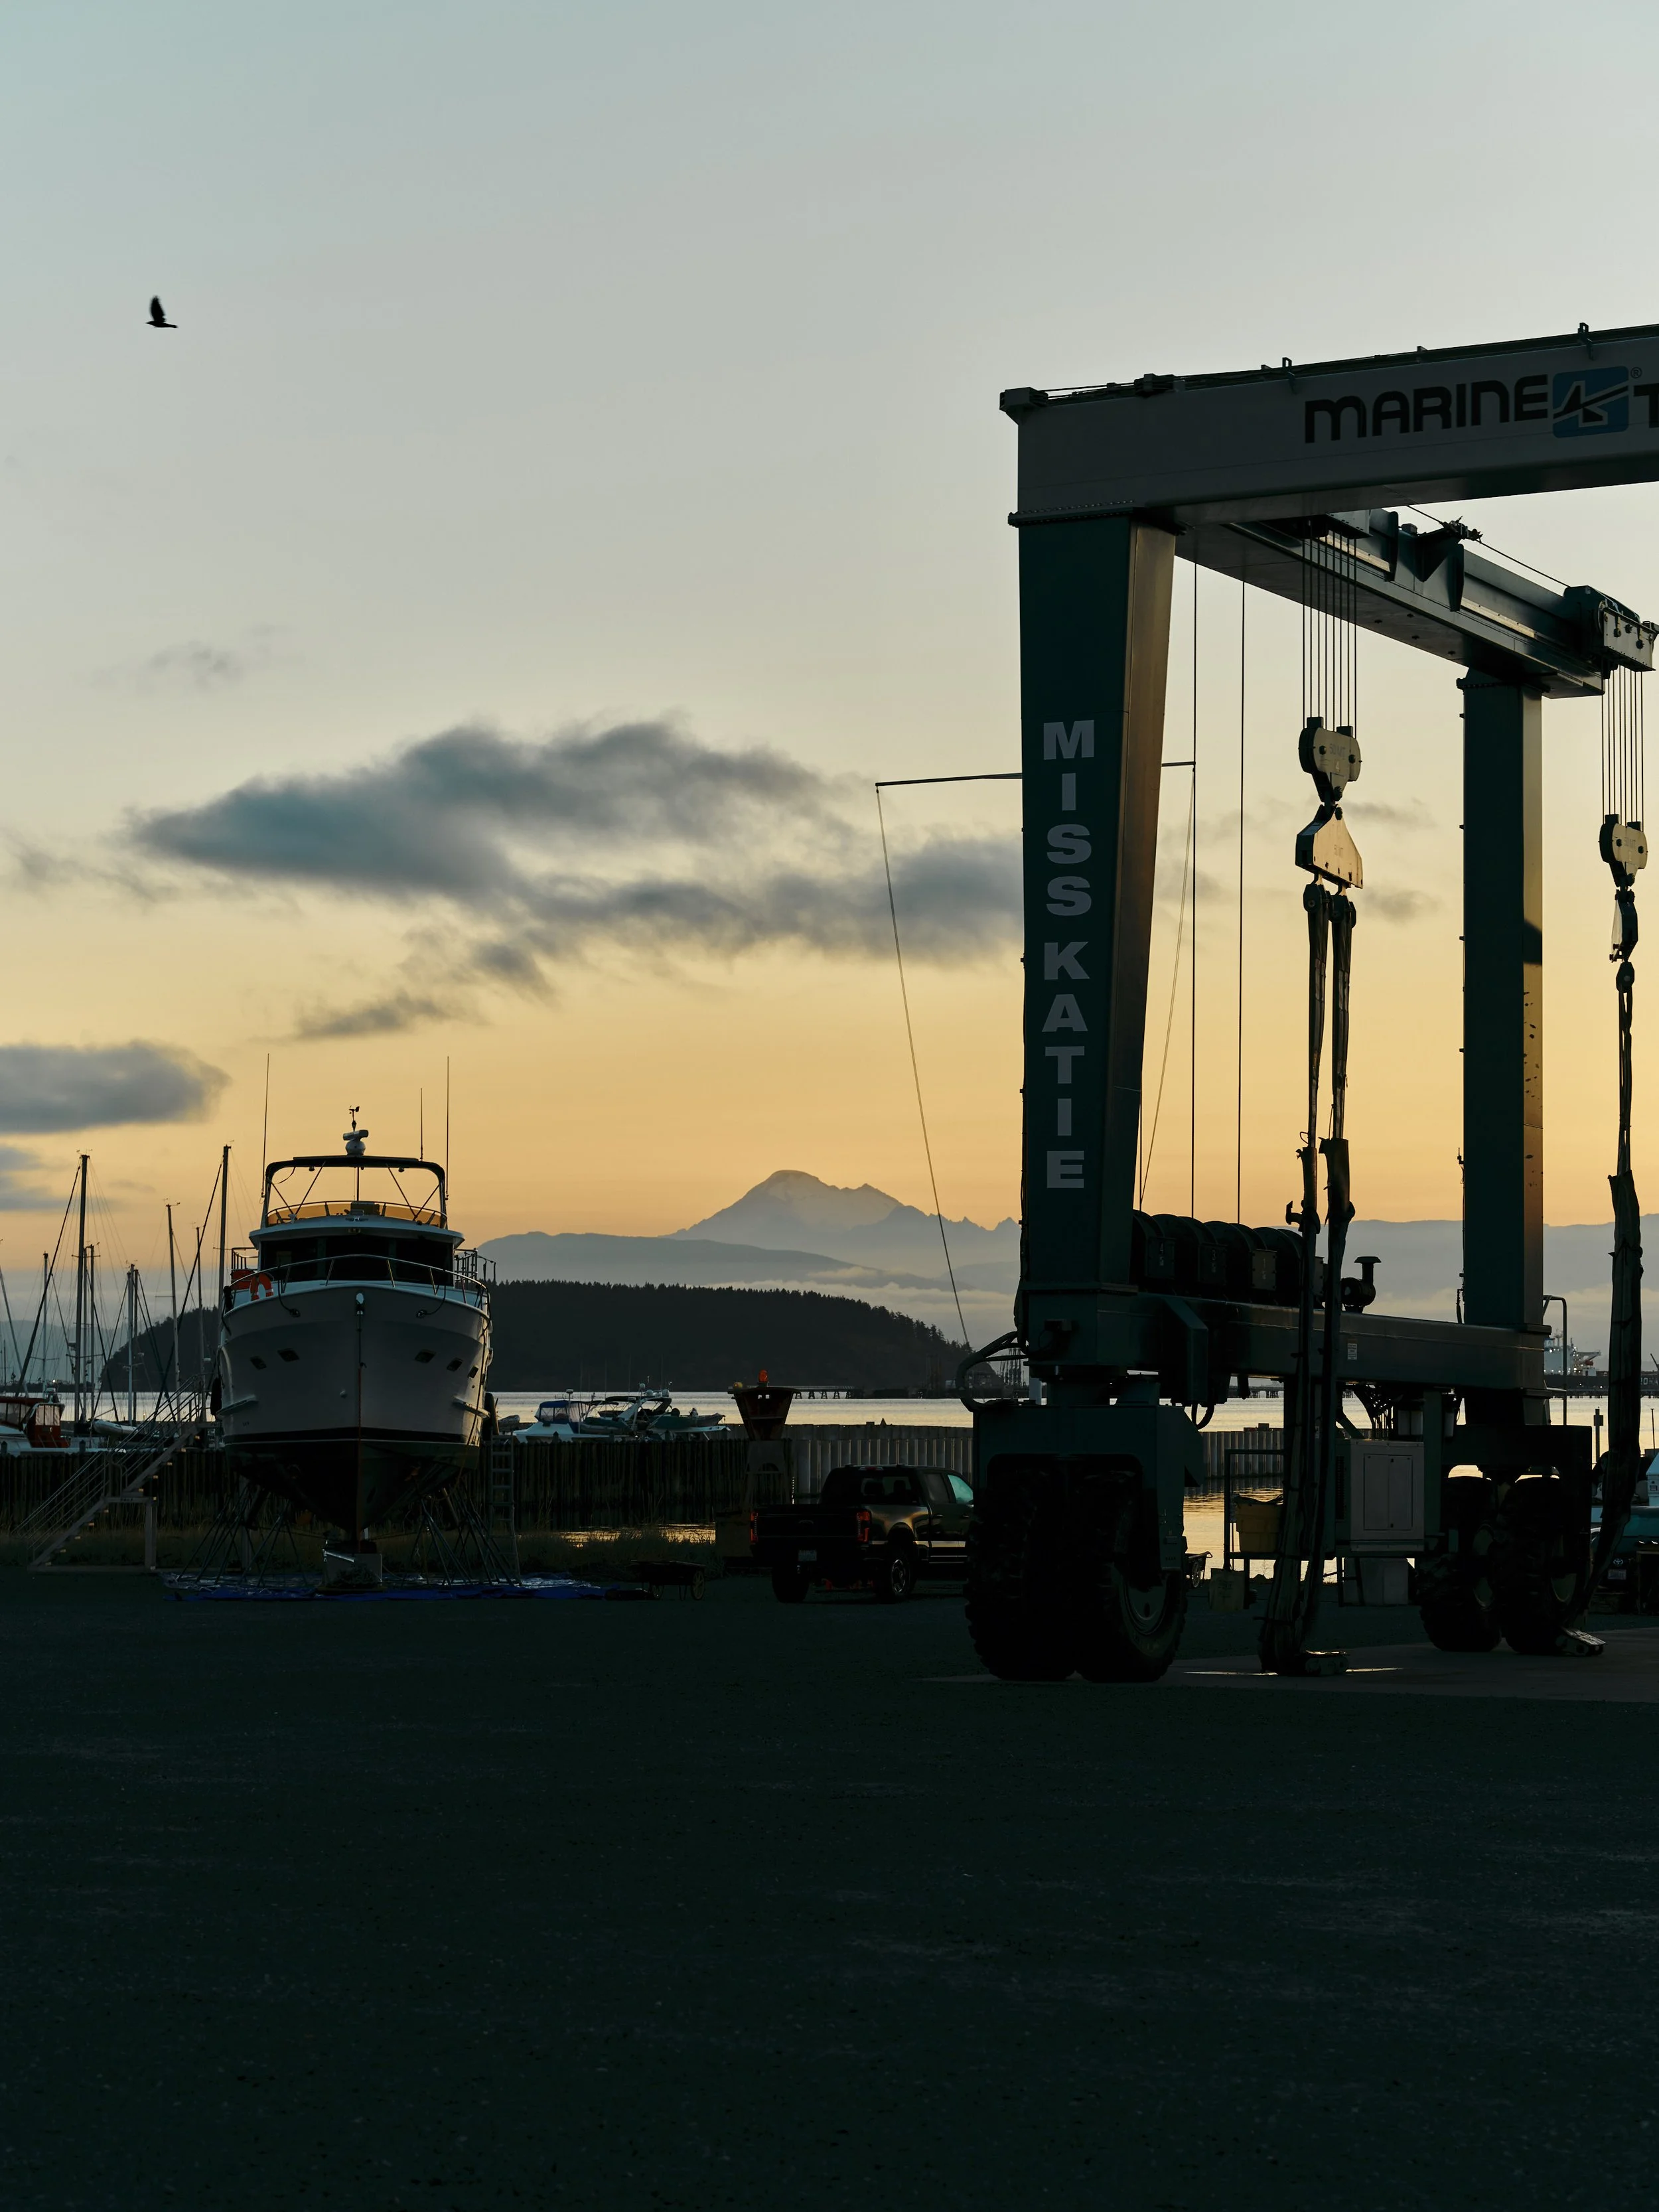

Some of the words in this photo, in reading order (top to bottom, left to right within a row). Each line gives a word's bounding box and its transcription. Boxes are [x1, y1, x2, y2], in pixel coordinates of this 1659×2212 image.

[1305, 374, 1548, 443] MARINE
[1043, 719, 1094, 917] MISS
[1041, 941, 1090, 1189] KATIE
